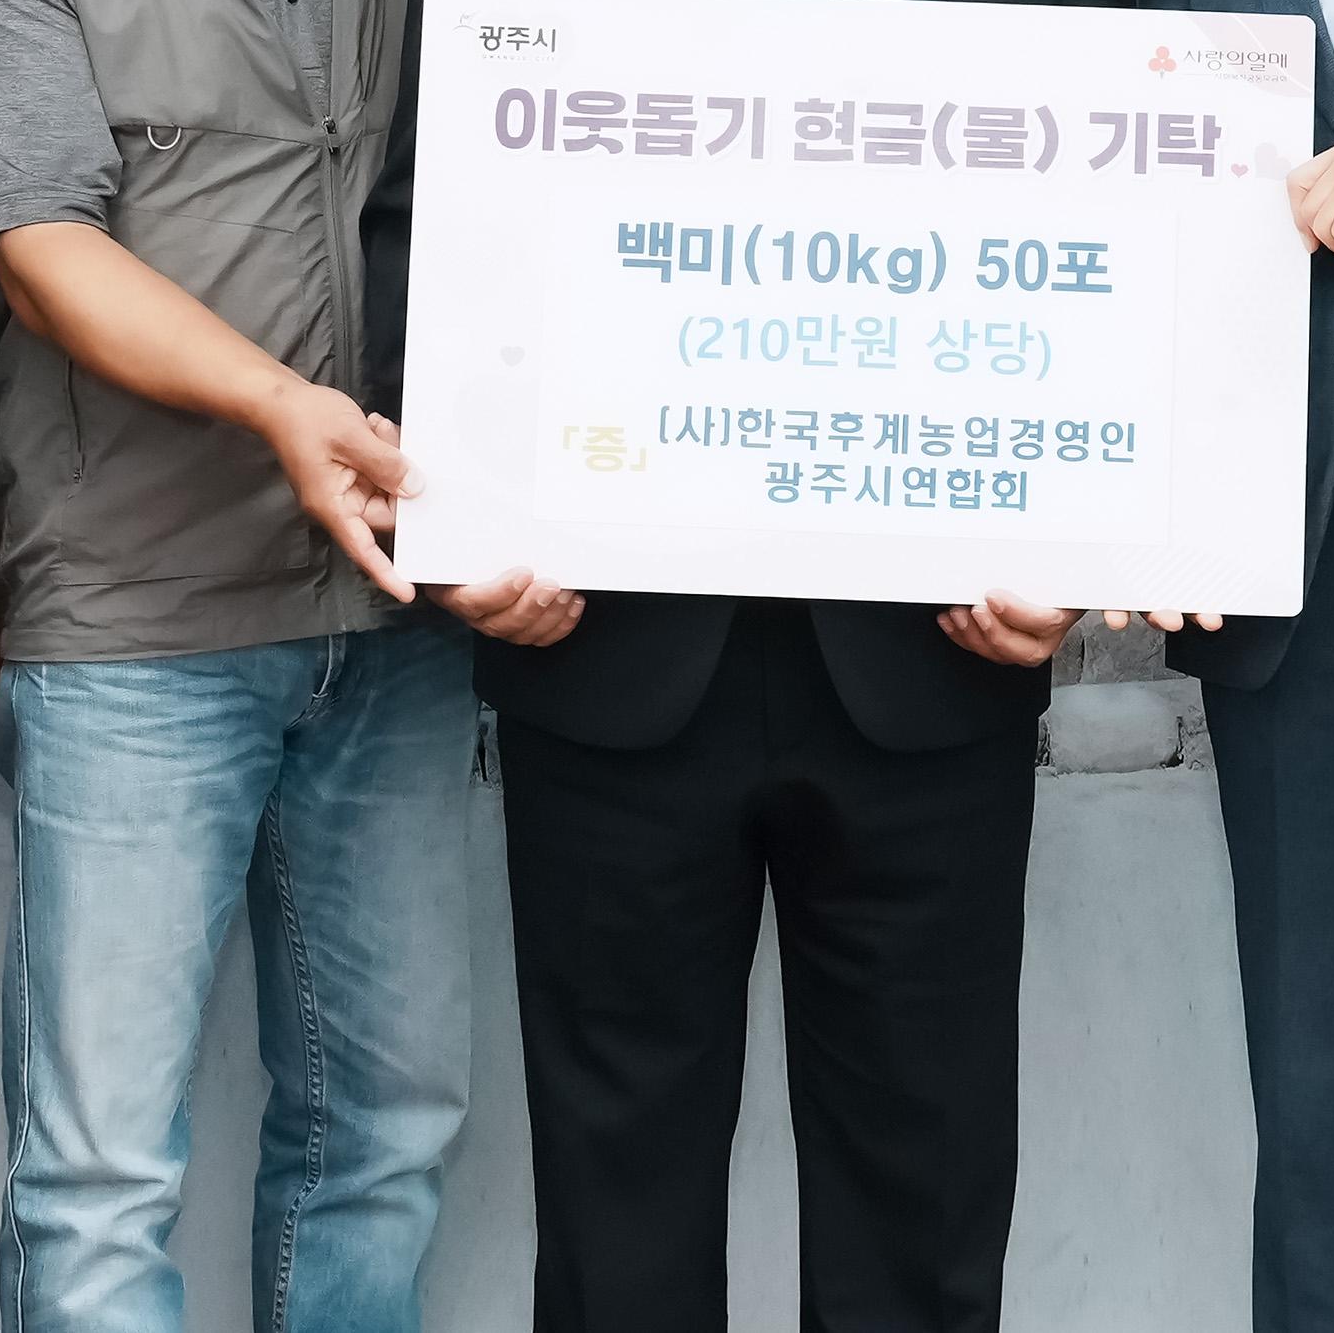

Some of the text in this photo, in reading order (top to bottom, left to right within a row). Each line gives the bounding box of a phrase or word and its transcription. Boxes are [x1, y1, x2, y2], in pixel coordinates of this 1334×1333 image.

[478, 25, 556, 53] 광주시
[1184, 50, 1288, 72] 사랑의열매
[495, 87, 1222, 177] 이웃돕기 현금(물) 기탁
[618, 221, 1113, 294] 백미(10kg) 50포
[678, 313, 1052, 381] (210만원 상당)
[764, 462, 1028, 512] 광주시연합회
